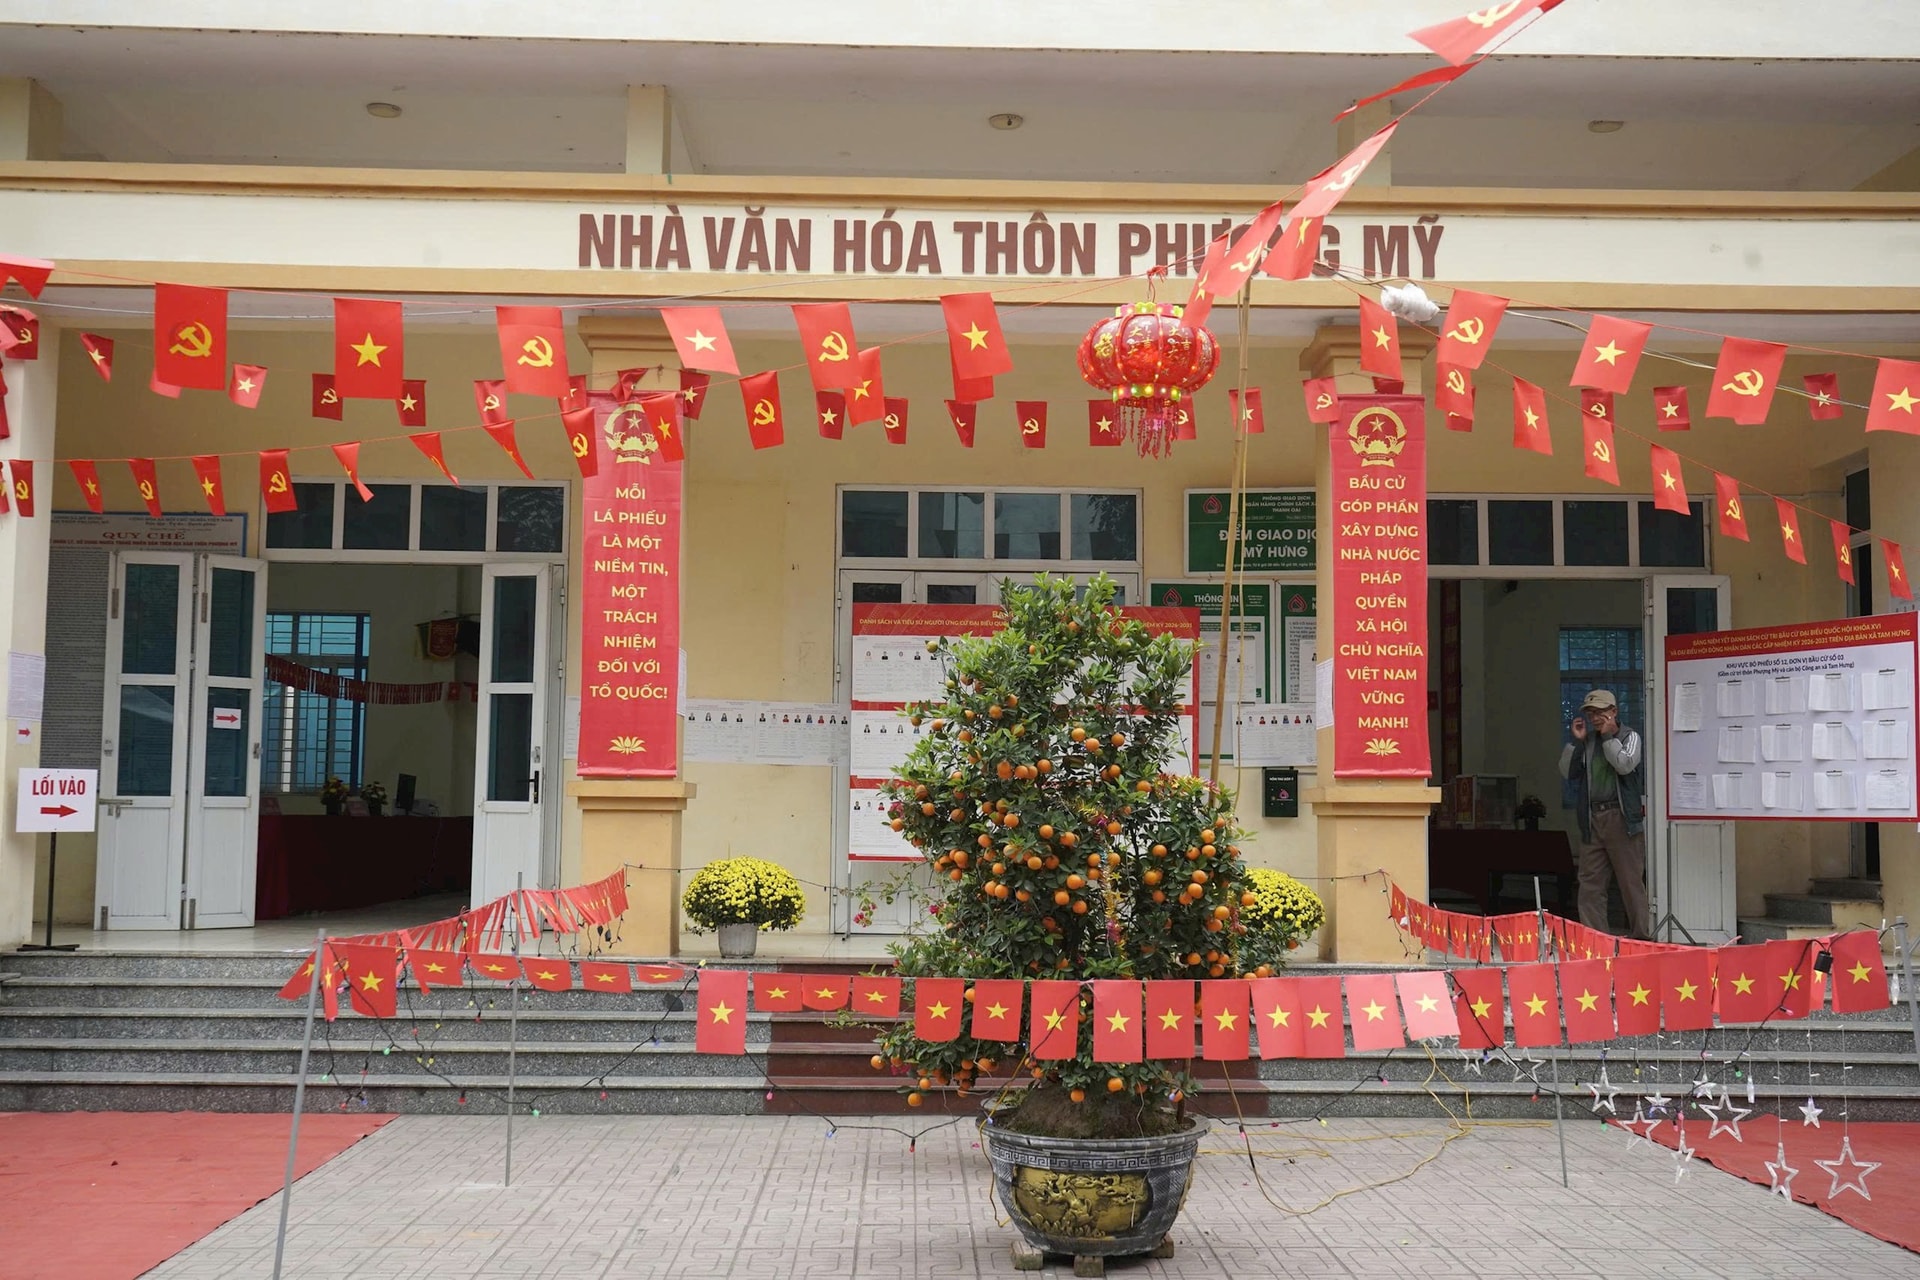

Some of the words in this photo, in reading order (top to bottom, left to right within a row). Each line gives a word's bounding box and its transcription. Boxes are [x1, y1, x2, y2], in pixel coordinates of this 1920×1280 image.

[578, 204, 691, 270] NHÀ
[703, 205, 811, 271] VĂN
[833, 207, 942, 274] HÓA
[953, 209, 1096, 276] THÔN
[1118, 217, 1341, 277] PHƯG
[1363, 213, 1444, 278] MỸ
[1349, 475, 1380, 490] BẦU
[1385, 476, 1406, 490] CỬ
[616, 483, 646, 500] MỖI
[1340, 498, 1373, 514] GÓP
[1377, 499, 1419, 515] PHẦN
[594, 509, 614, 524] LÁ
[618, 509, 667, 526] PHIẾU
[102, 532, 141, 540] QUY
[1219, 521, 1252, 541] ĐỂM
[1256, 529, 1293, 541] GIAO
[1341, 522, 1371, 537] XÂY
[1375, 524, 1419, 540] DỰNG
[602, 533, 623, 548] LÀ
[627, 534, 662, 552] MỘT
[1244, 544, 1264, 558] MỸ
[1268, 545, 1308, 558] HƯNG
[1340, 545, 1373, 561] NHÀ
[1377, 546, 1421, 562] NƯỚC
[594, 558, 635, 573] NIỀM
[639, 561, 669, 576] TIN,
[1360, 569, 1402, 585] PHÁP
[611, 584, 647, 601] MỘT
[1194, 593, 1223, 603] THÔNG
[1355, 592, 1407, 610] QUYỀN
[604, 609, 657, 624] TRÁCH
[1356, 619, 1377, 633] XÃ
[1380, 618, 1407, 635] HỘI
[1824, 626, 1840, 634] QUỐC
[1841, 625, 1852, 634] HỘI
[604, 634, 656, 652] NHIỆM
[1801, 638, 1828, 646] 2026-2031
[1891, 629, 1911, 637] HƯNG
[1340, 642, 1373, 656] CHỦ
[1376, 642, 1423, 657] NGHĨA
[598, 657, 628, 673] ĐỐI
[632, 658, 660, 674] VỚI
[1758, 658, 1773, 667] PHIẾU
[1773, 658, 1781, 666] SỐ
[1809, 655, 1820, 663] BẦU
[1820, 654, 1828, 662] CỬ
[1829, 653, 1836, 661] SỐ
[1347, 666, 1380, 683] VIỆT
[1383, 669, 1417, 681] NAM
[1753, 668, 1771, 676] Phượng
[1802, 664, 1814, 672] Công
[589, 682, 612, 698] TỔ
[616, 683, 668, 701] QUỐC!
[1361, 689, 1405, 705] VỮNG
[1358, 717, 1408, 731] MẠNH!
[32, 774, 54, 796] LỐI
[59, 776, 86, 796] VÀO
